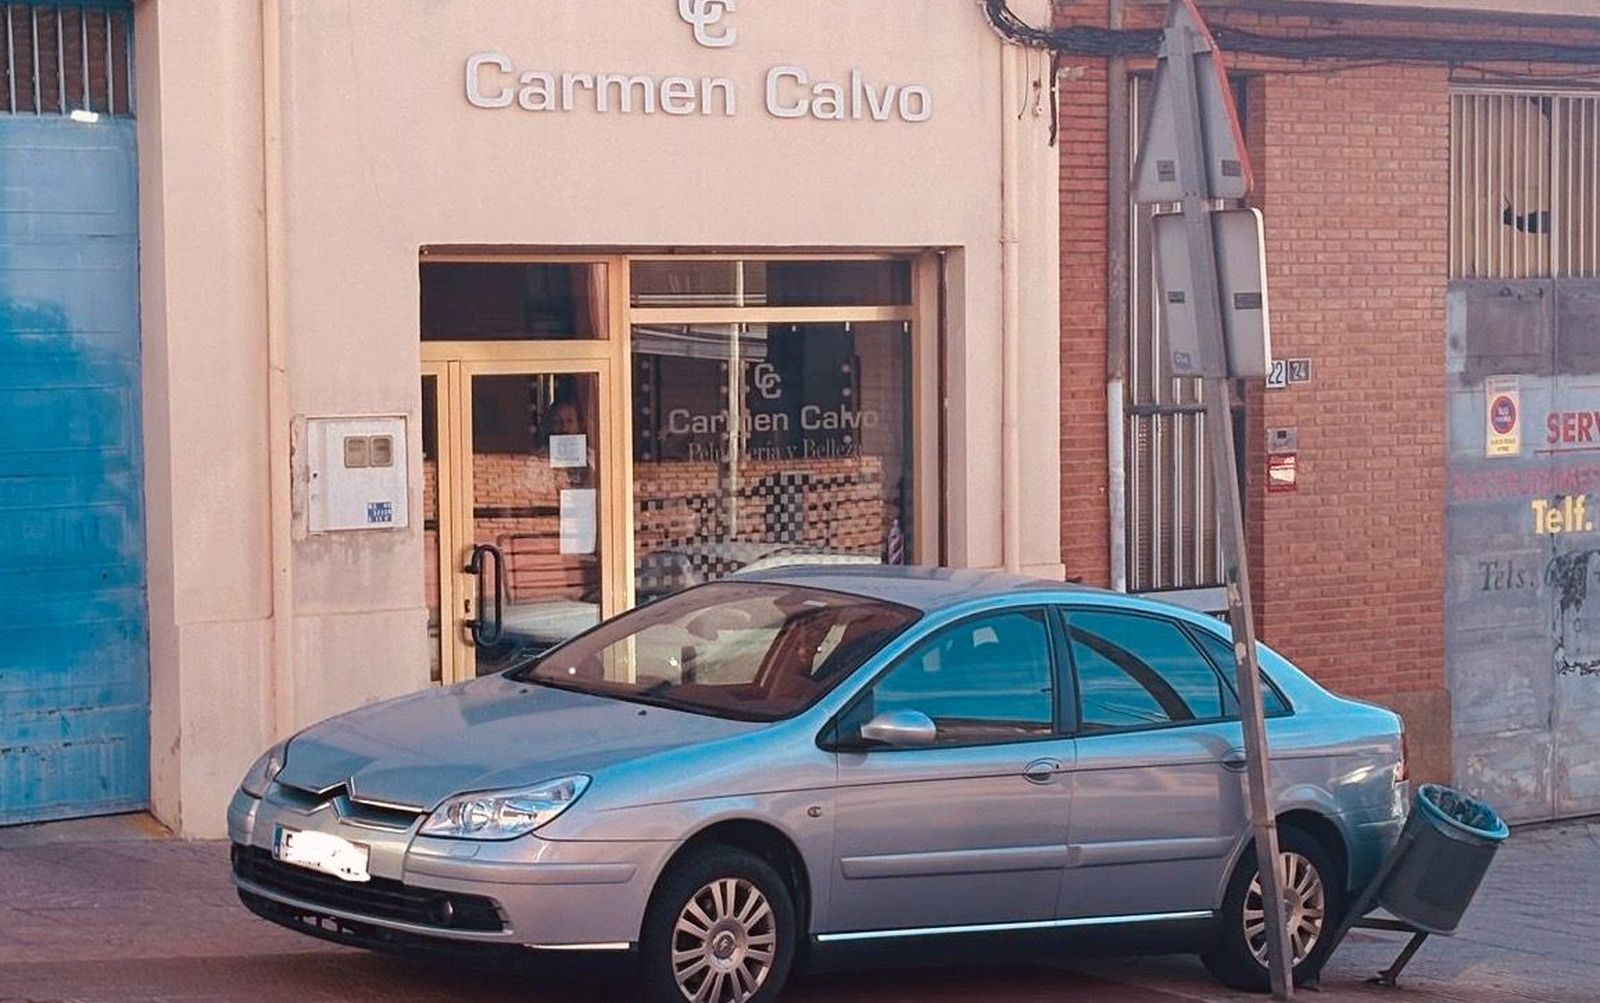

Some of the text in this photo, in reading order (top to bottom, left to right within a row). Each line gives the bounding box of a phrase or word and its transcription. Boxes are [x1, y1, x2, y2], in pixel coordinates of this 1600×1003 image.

[466, 52, 932, 121] Carmen Calvo
[1268, 362, 1283, 384] 22
[1292, 362, 1306, 380] 24
[801, 404, 878, 430] Calvo
[1531, 494, 1593, 534] Telf.
[1479, 560, 1534, 591] Tels.
